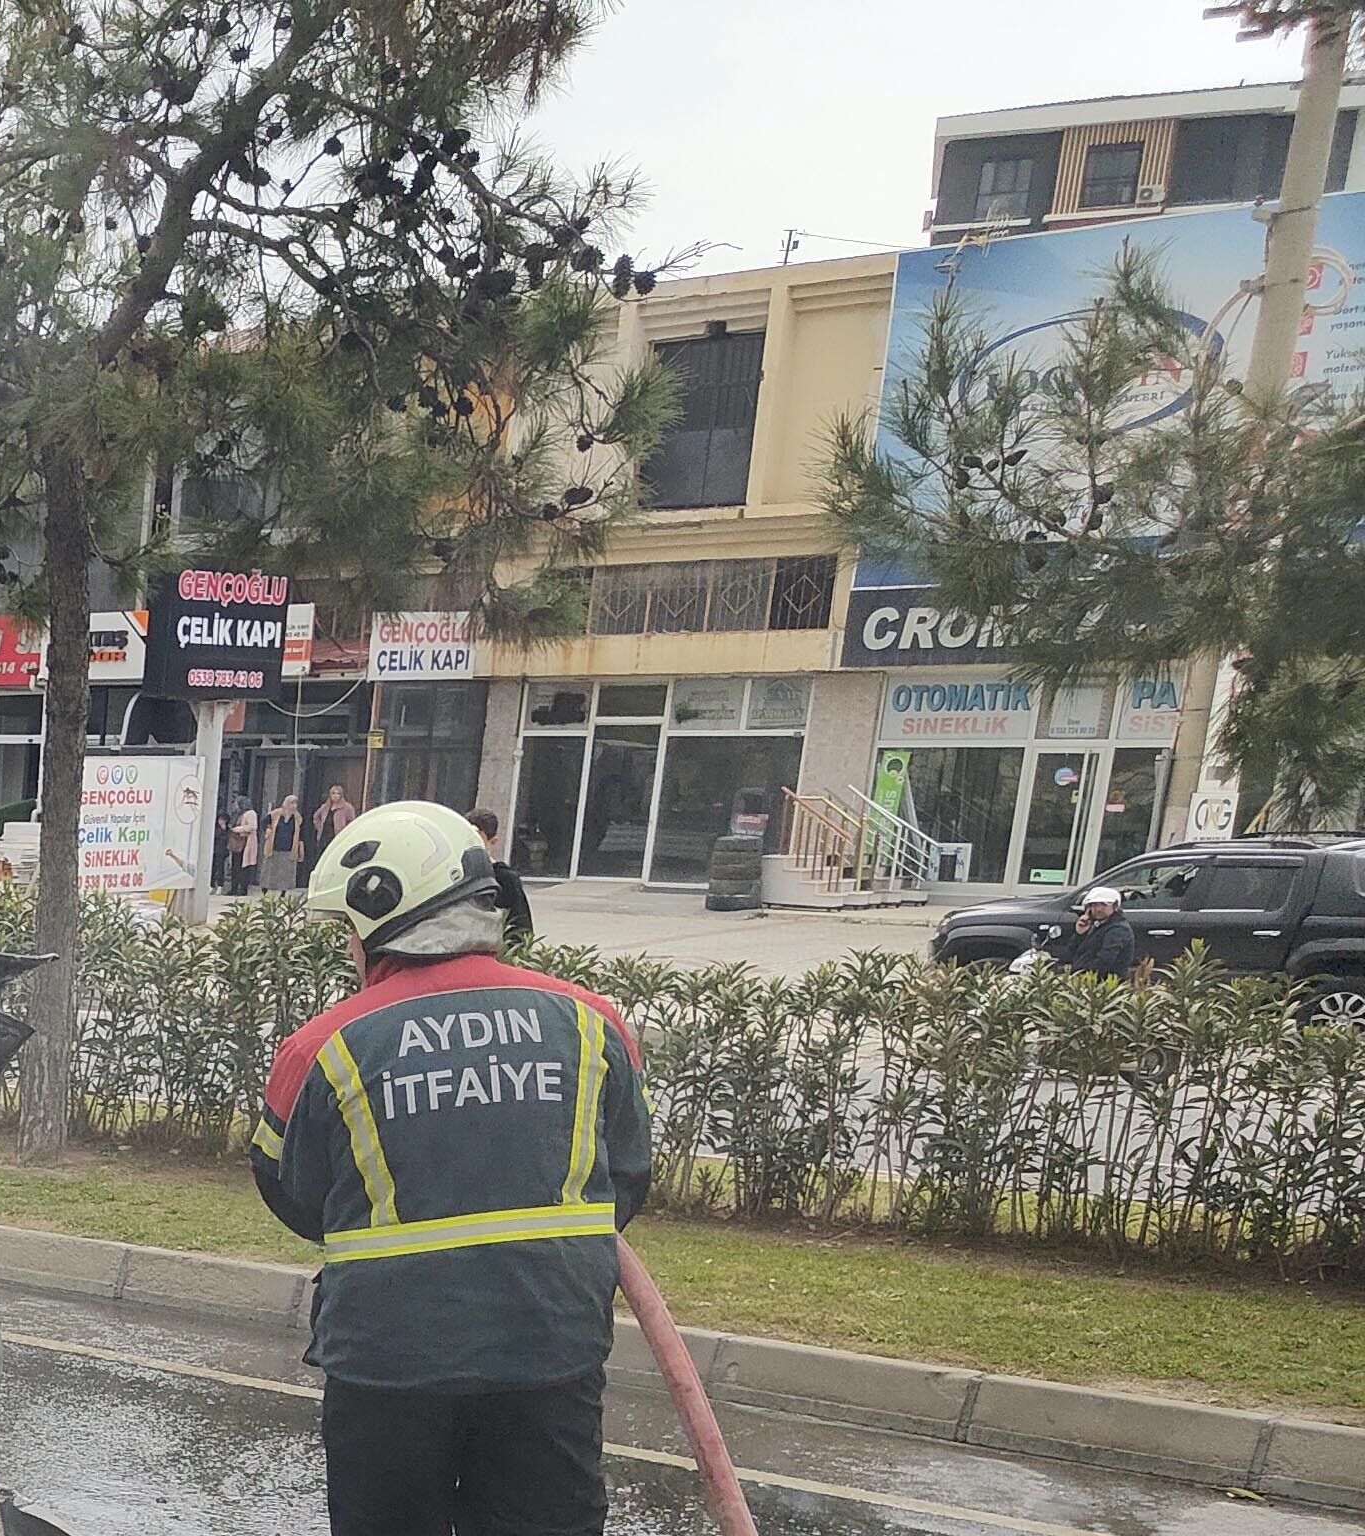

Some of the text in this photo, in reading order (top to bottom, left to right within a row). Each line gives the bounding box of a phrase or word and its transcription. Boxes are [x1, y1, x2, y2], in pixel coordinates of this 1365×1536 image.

[178, 568, 287, 608] GENÇOĞLU
[176, 612, 283, 649] ÇELİK KAPI
[861, 605, 1021, 651] CROM
[376, 645, 470, 676] ÇELİK KAPI
[187, 668, 264, 688] 0538 783 42 06
[891, 680, 1178, 712] OTOMATİK PA
[81, 787, 153, 808] GENÇOĞLU
[77, 827, 150, 845] Çelik Kapı
[84, 874, 100, 890] 538
[103, 873, 119, 888] 783
[119, 873, 131, 888] 42
[132, 872, 143, 887] 06
[397, 1008, 543, 1058] AYDIN
[381, 1054, 563, 1120] İTFAİYE
